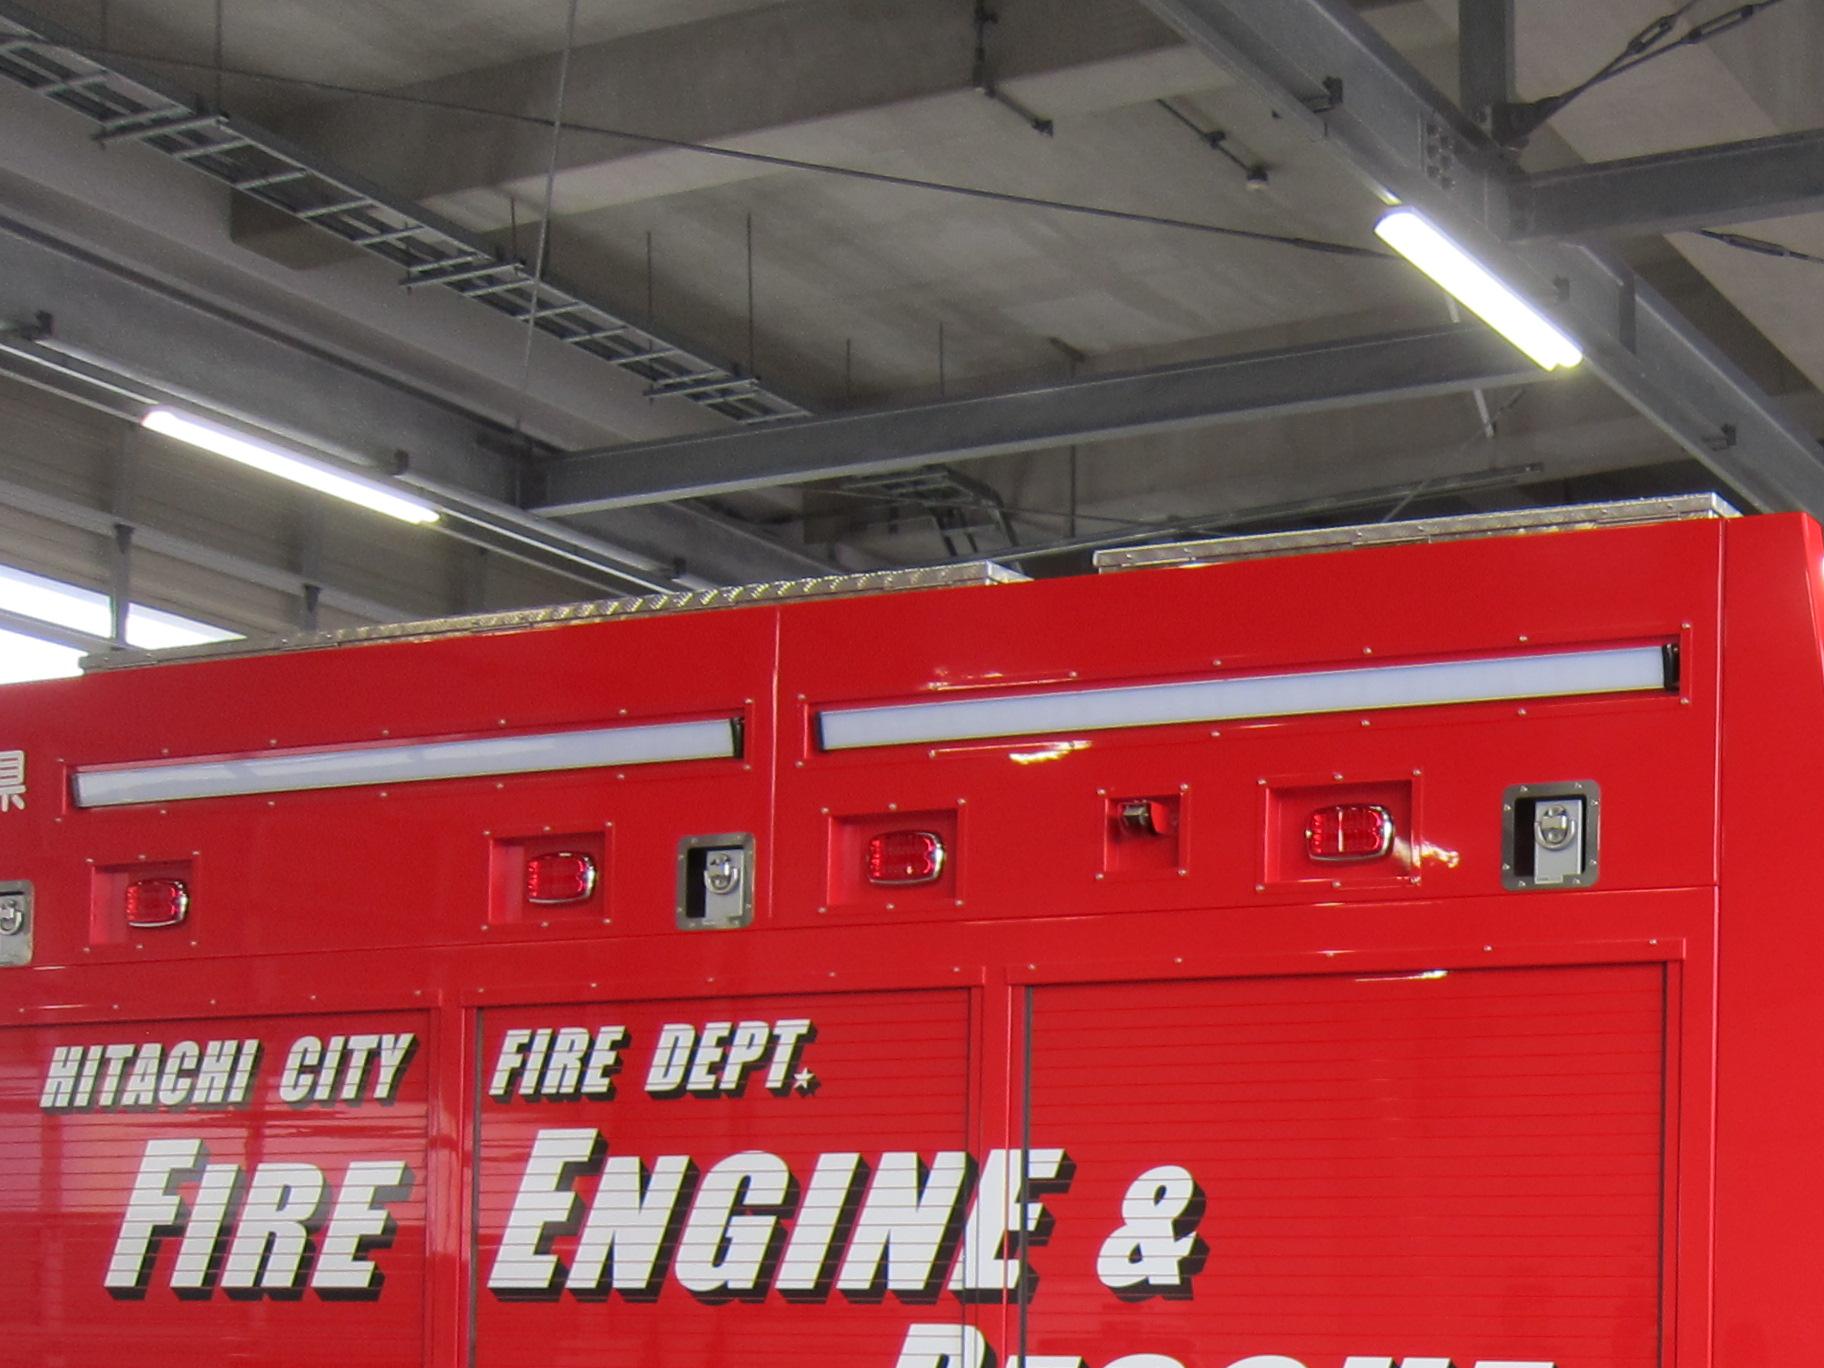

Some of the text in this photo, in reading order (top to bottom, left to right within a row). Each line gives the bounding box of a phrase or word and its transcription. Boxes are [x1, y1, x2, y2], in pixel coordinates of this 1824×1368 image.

[39, 1039, 261, 1109] HITACHI
[278, 1033, 418, 1104] CITY
[489, 1026, 628, 1099] FIRE
[104, 1128, 1206, 1296] FIRE ENGINE &
